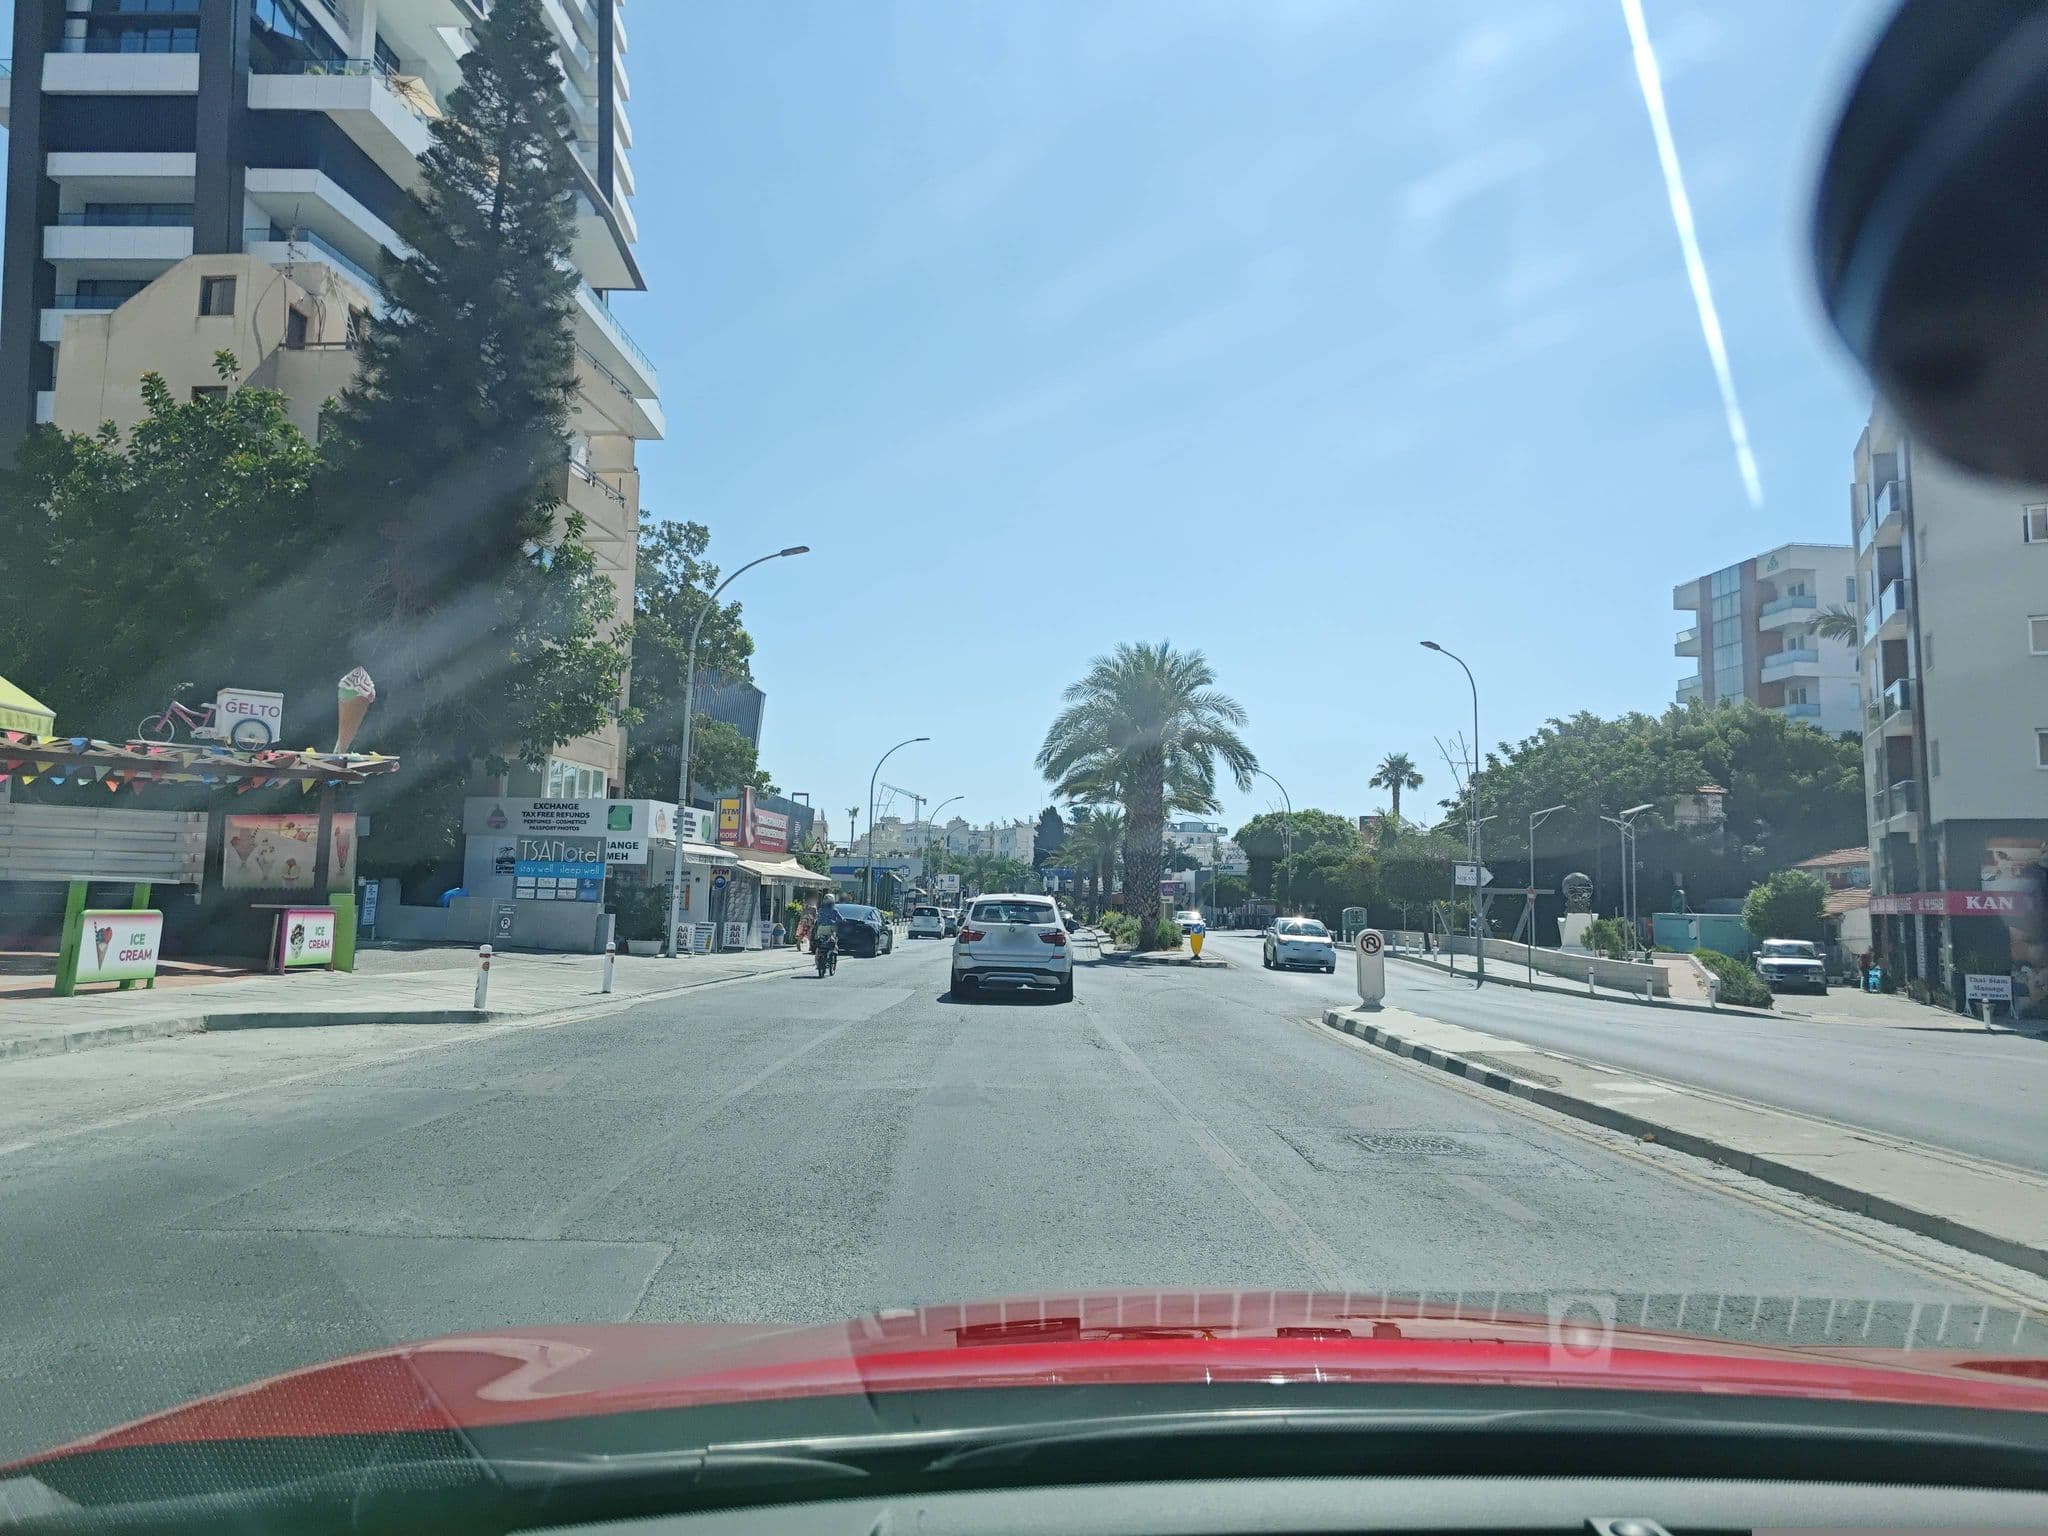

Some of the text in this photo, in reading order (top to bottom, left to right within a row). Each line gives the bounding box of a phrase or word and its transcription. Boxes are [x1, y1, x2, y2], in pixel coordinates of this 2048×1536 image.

[225, 700, 280, 718] GELTO
[533, 802, 580, 810] EXCHANGE
[556, 811, 590, 819] REFUNDS
[719, 832, 738, 840] KIOSK
[519, 864, 536, 873] stay
[538, 864, 554, 873] well
[559, 864, 581, 875] sleep
[583, 865, 600, 876] well
[314, 926, 326, 936] ICE
[129, 932, 146, 946] ICE
[308, 939, 331, 949] CREAM
[118, 948, 153, 962] CREAM
